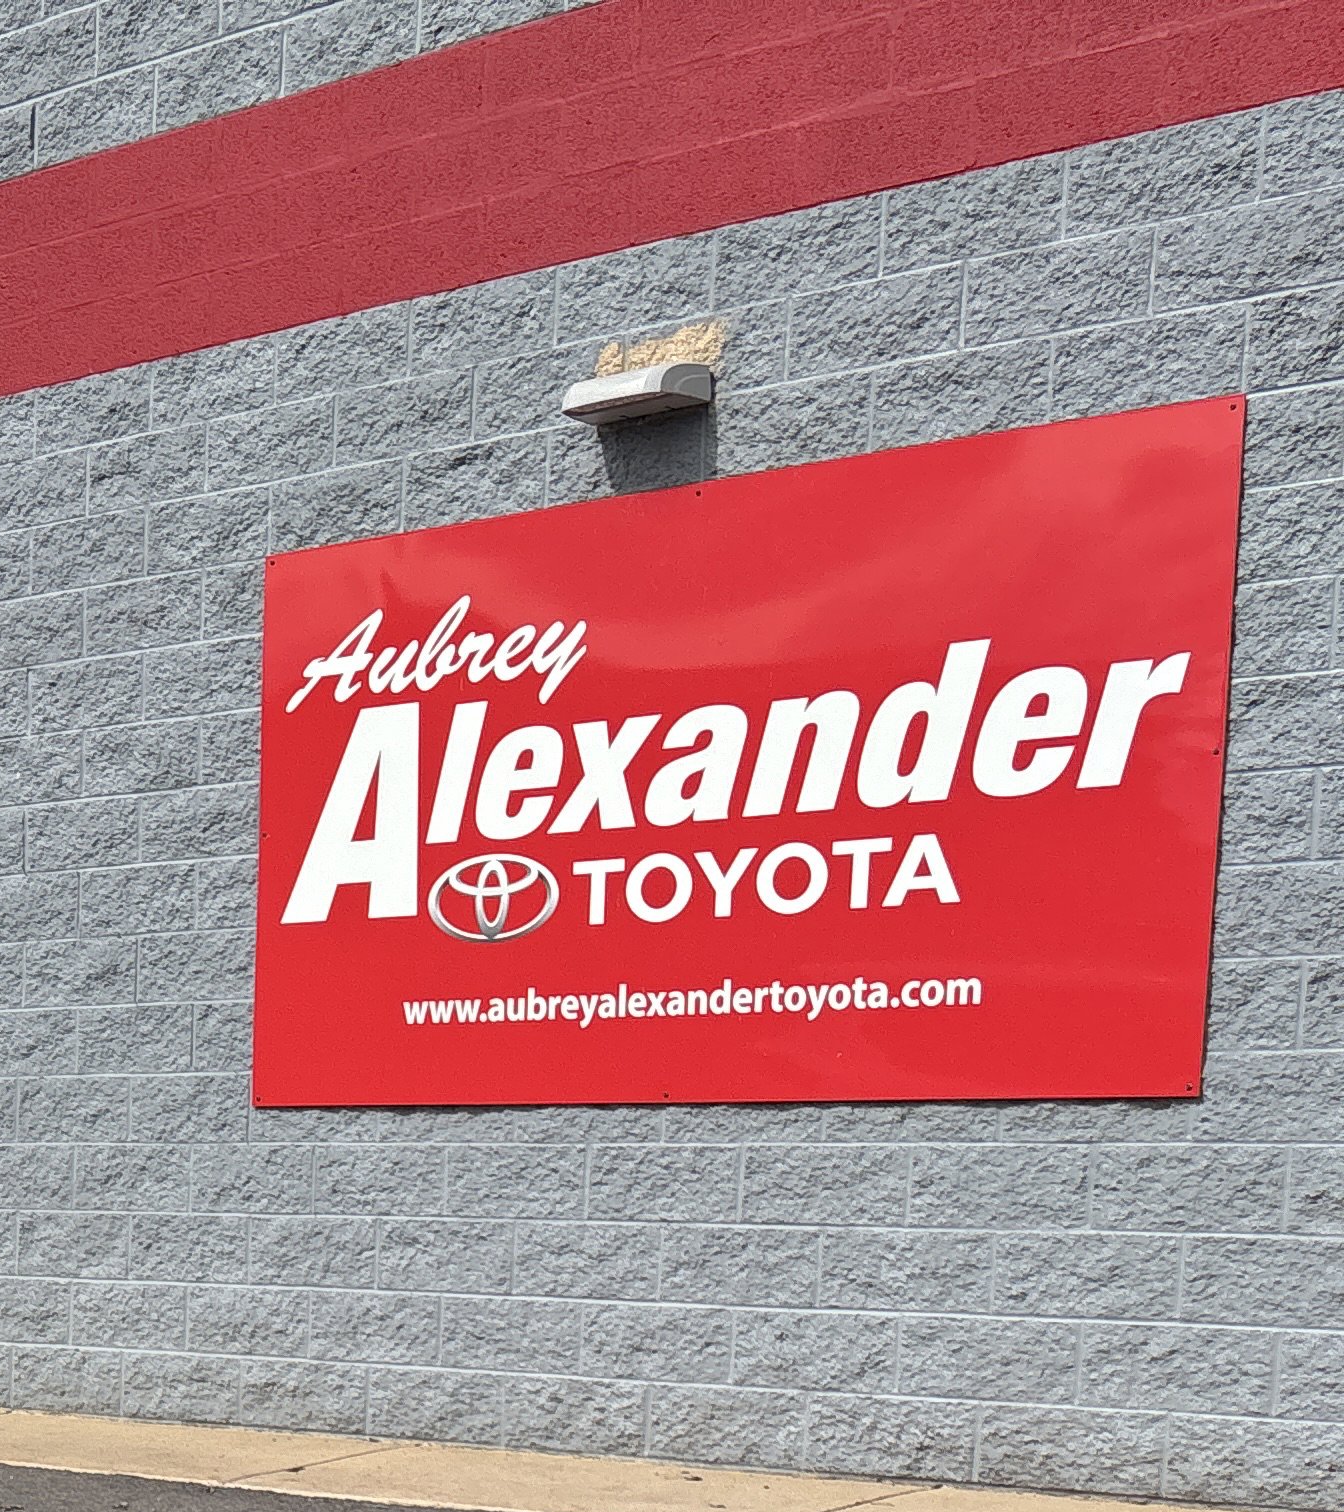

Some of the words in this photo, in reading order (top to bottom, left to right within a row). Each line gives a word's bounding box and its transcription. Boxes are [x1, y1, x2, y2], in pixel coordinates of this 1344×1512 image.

[285, 594, 588, 713] Aubrey
[280, 638, 1191, 925] Alexander
[572, 833, 961, 926] TOYOTA
[403, 976, 982, 1029] www.aubreyalexandertoyota.com
